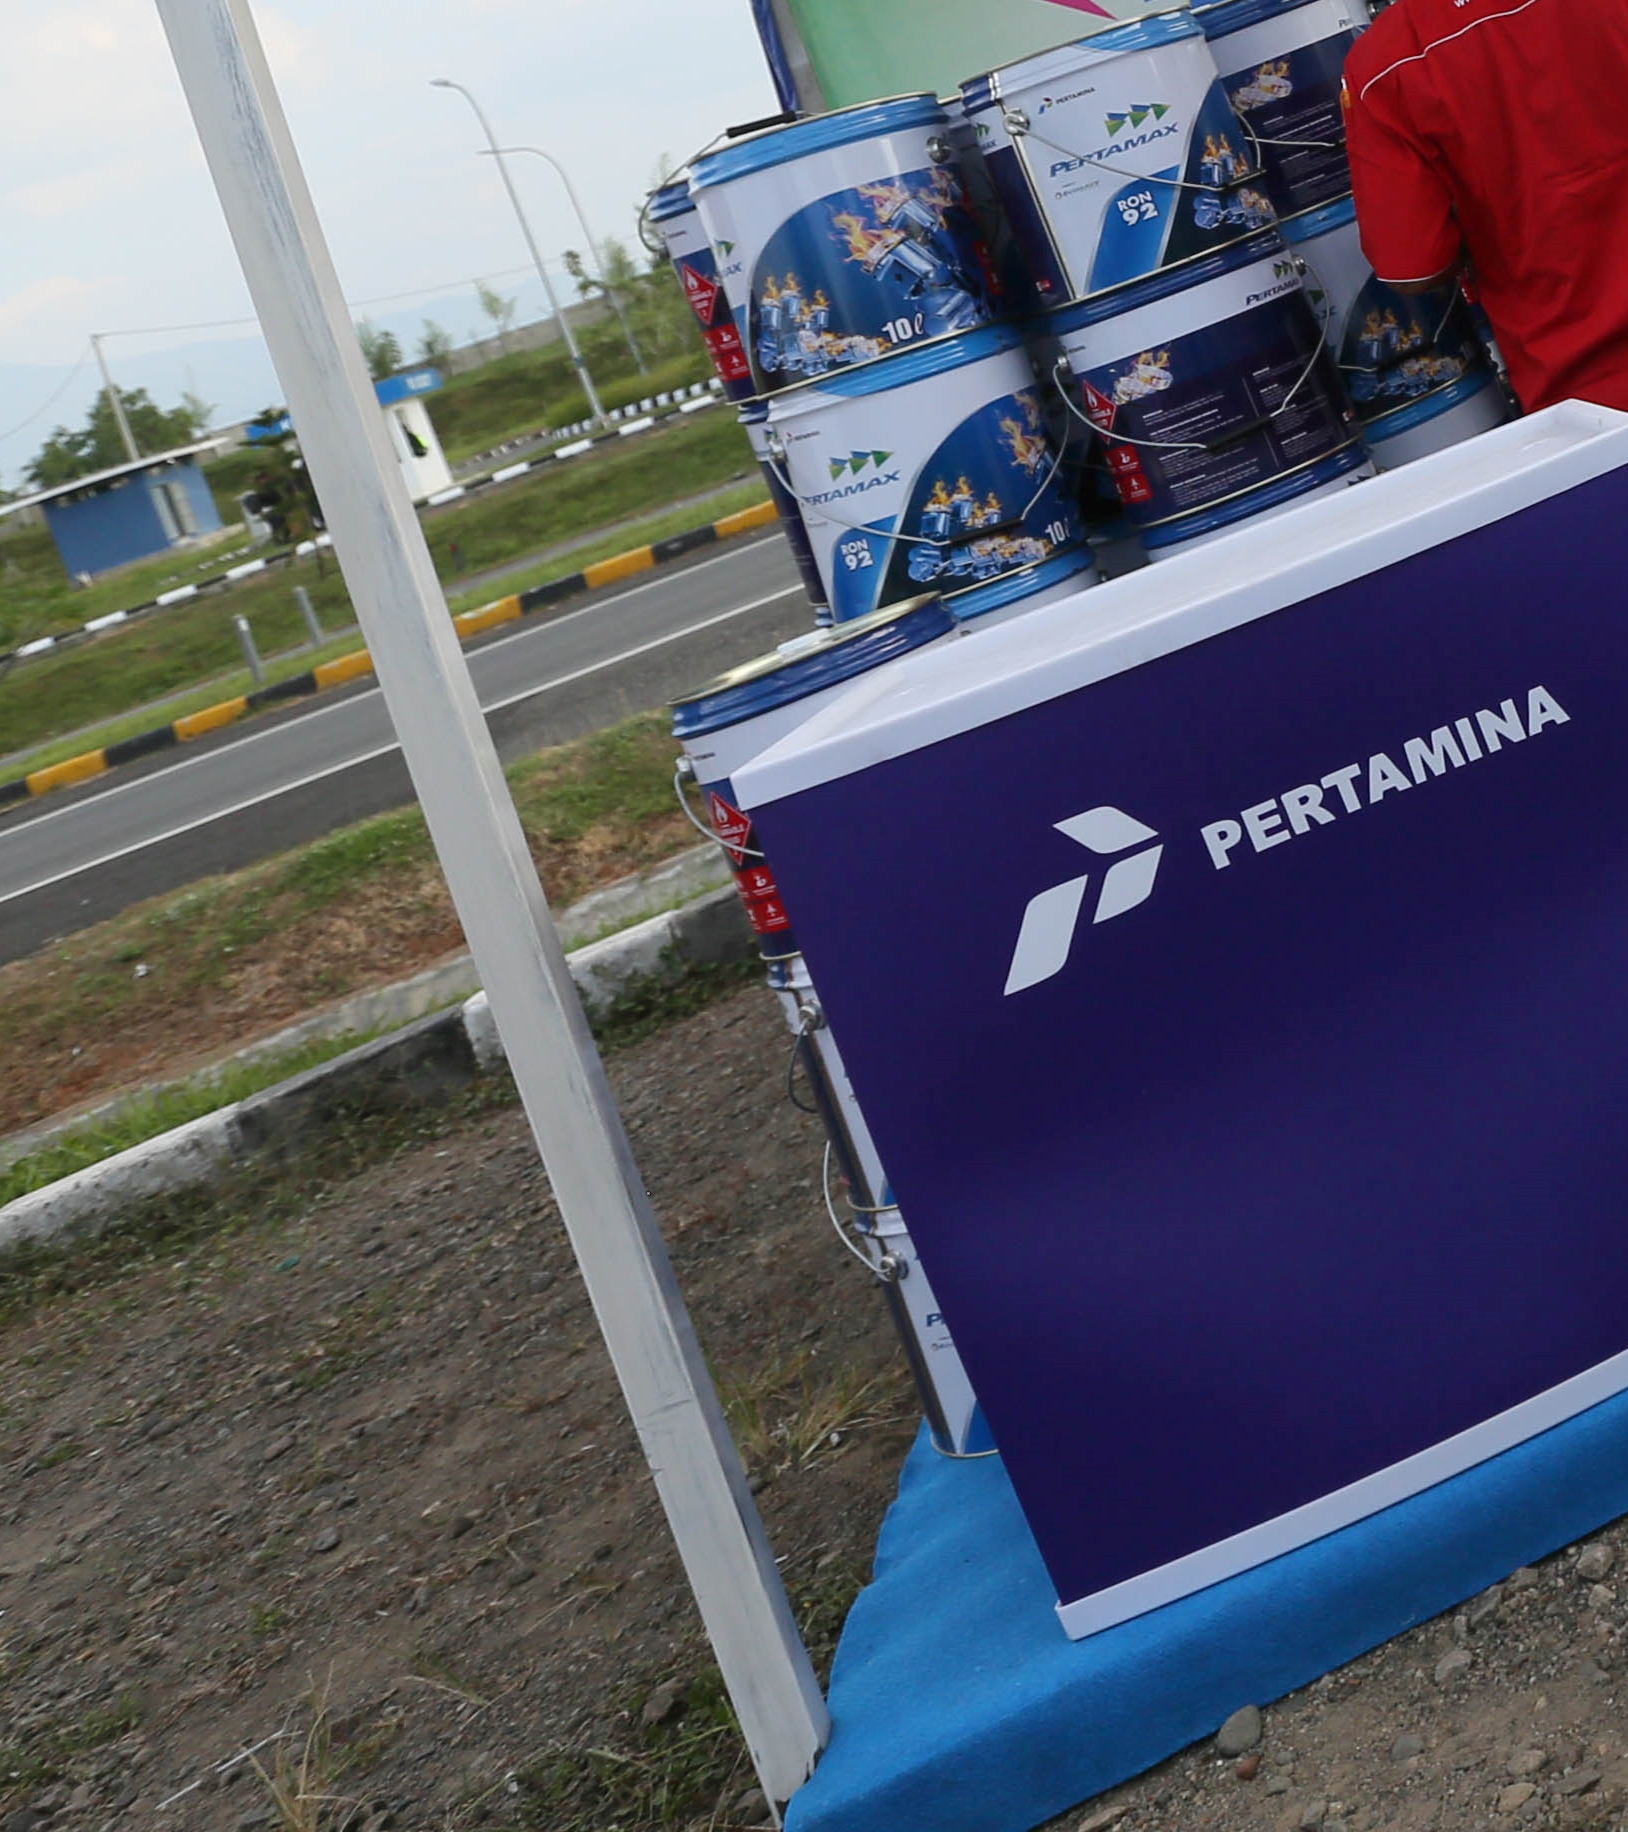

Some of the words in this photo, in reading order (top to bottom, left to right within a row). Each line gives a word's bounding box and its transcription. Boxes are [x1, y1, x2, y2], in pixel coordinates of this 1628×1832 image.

[1050, 122, 1179, 178] PERTAMAX
[1117, 190, 1153, 212] RON
[1122, 201, 1158, 226] 92
[840, 539, 868, 554] RON
[844, 550, 873, 571] 92
[1201, 685, 1571, 870] PERTAMINA
